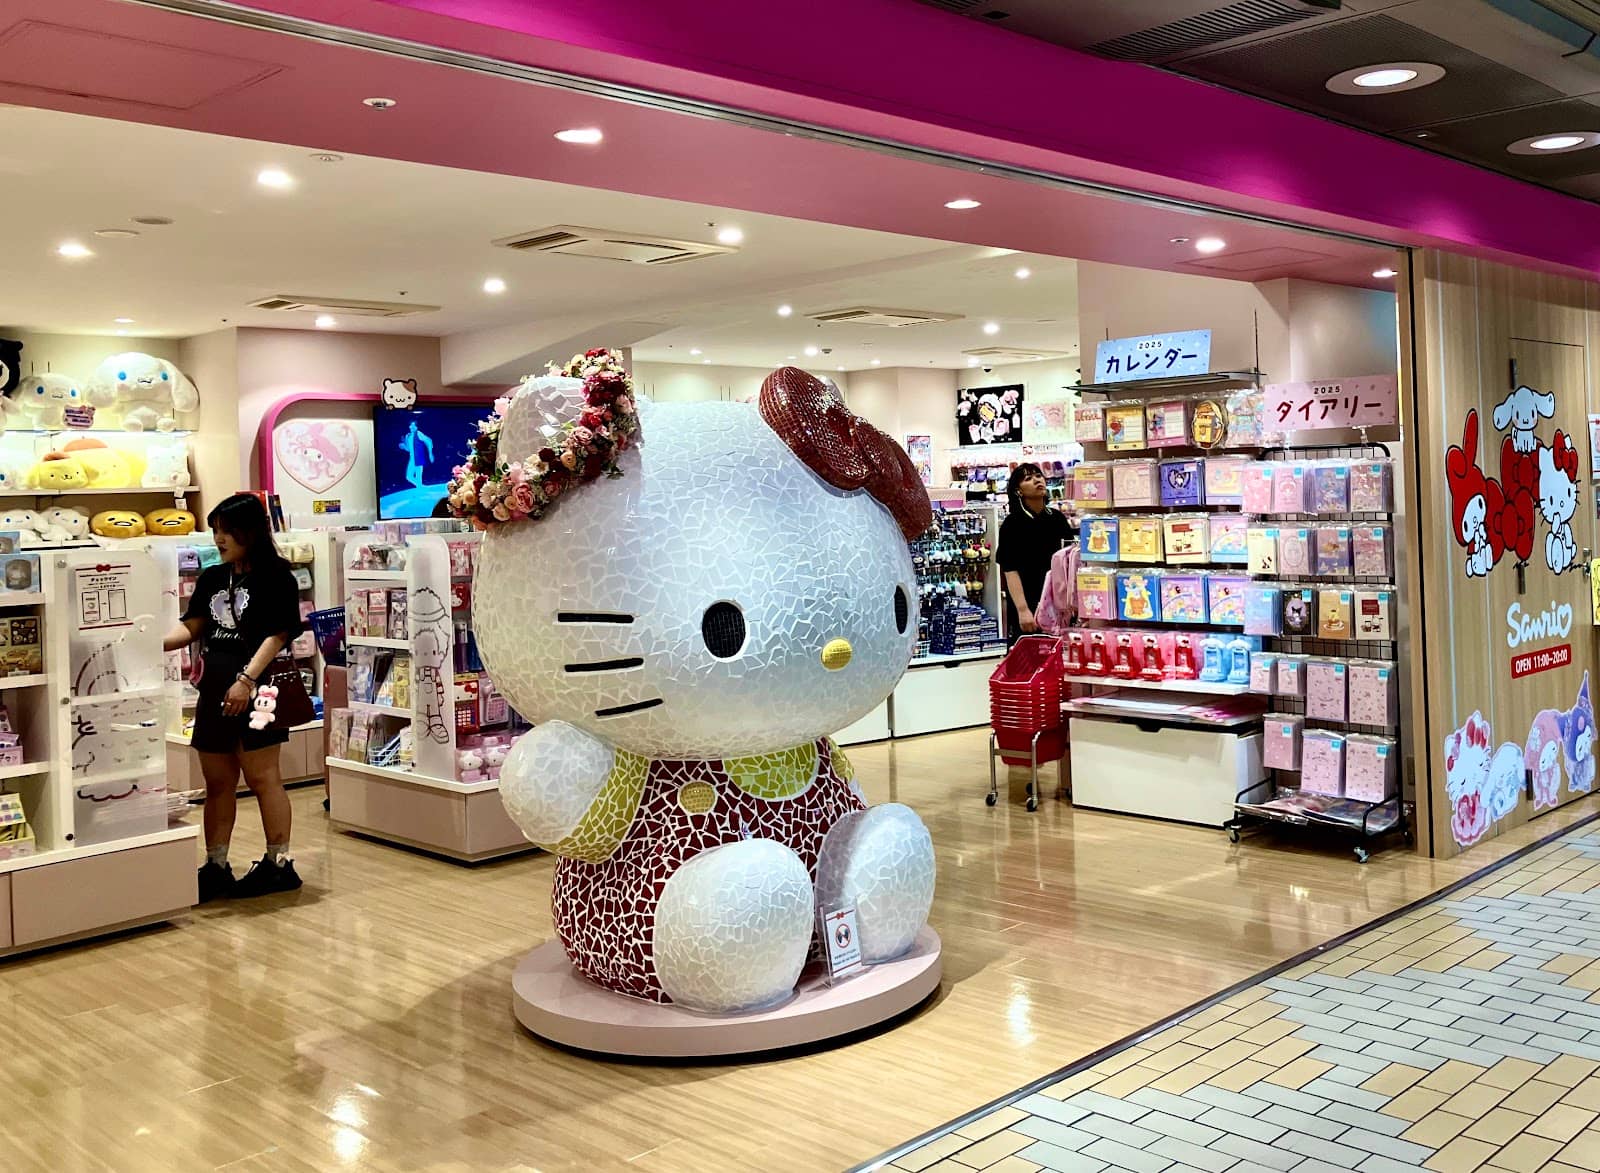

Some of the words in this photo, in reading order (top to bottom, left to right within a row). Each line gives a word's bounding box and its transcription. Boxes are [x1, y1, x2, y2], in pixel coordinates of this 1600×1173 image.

[1138, 341, 1162, 349] 2025
[1106, 347, 1197, 374] カレンダー
[1313, 385, 1340, 395] 2025
[1276, 395, 1381, 423] ダイアリー
[1507, 600, 1572, 648] Sanrio
[1515, 656, 1531, 673] OPEN
